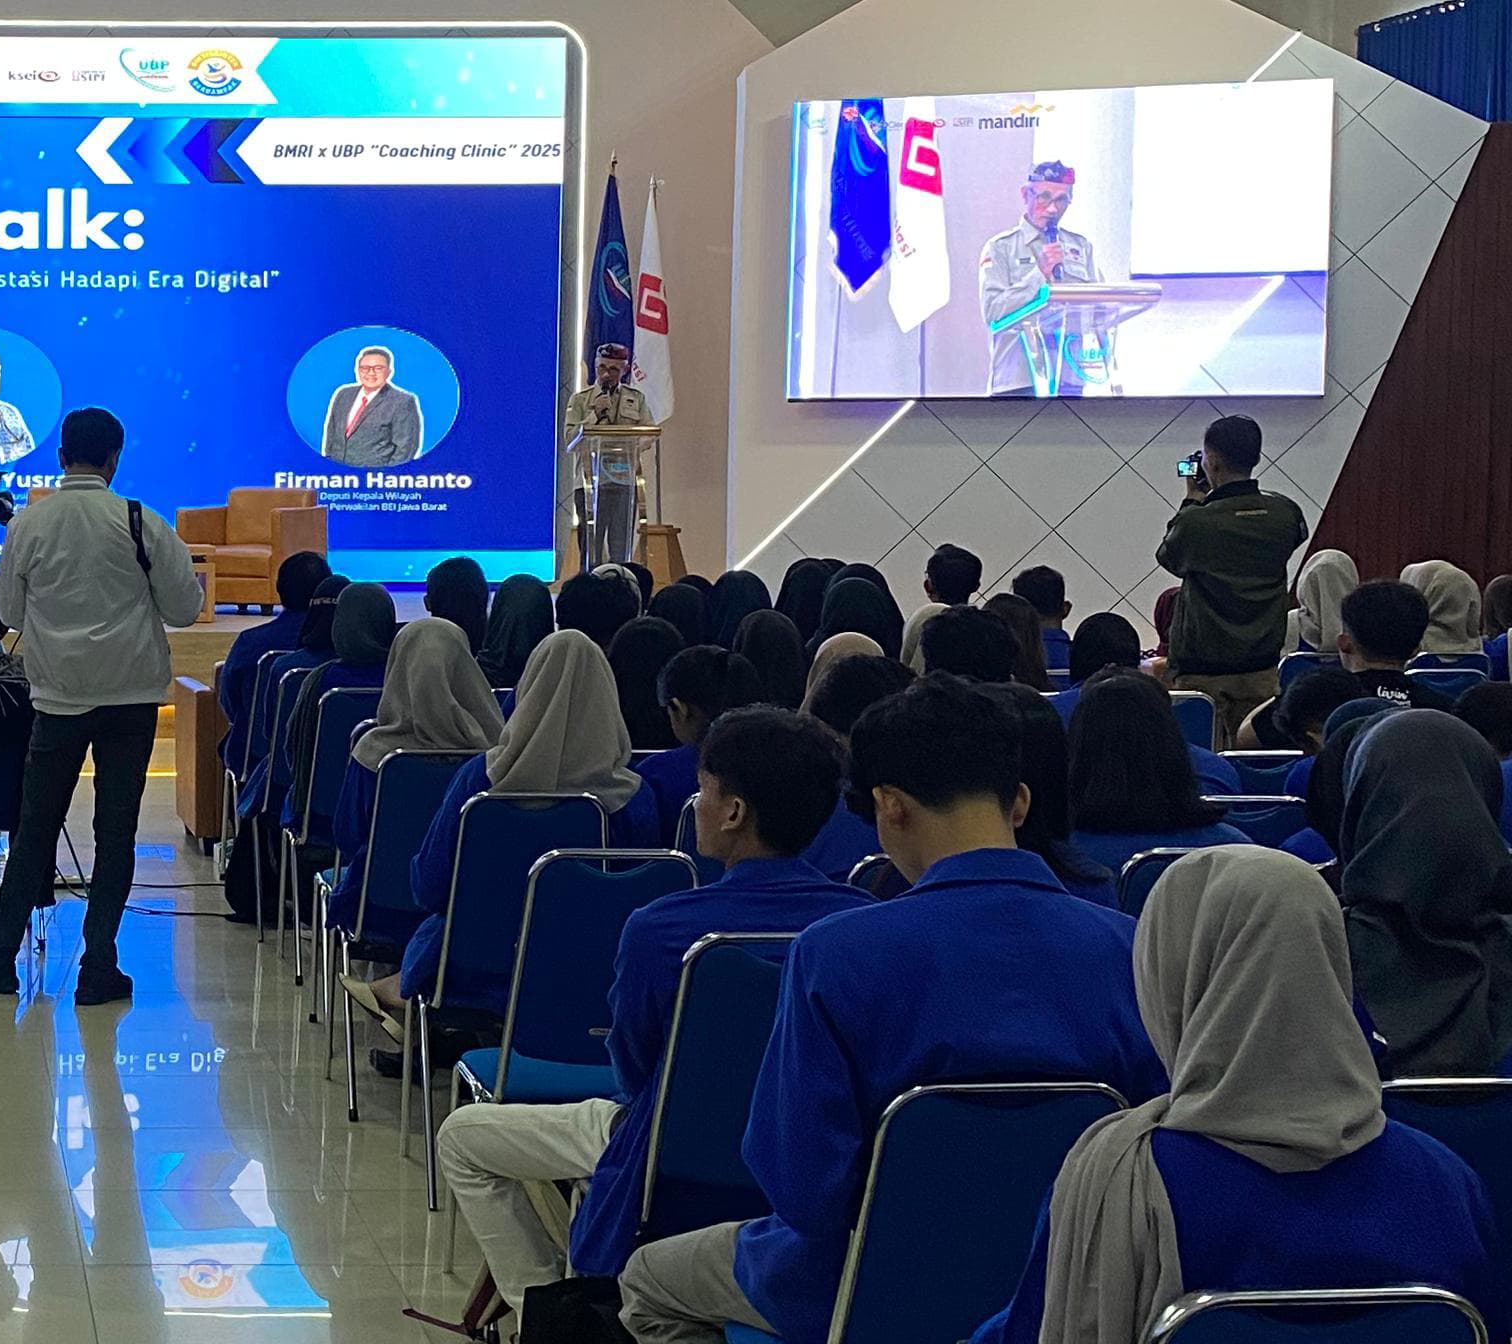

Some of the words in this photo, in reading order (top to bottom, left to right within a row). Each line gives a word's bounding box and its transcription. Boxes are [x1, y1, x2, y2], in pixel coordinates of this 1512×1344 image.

[139, 60, 169, 71] UBP
[273, 144, 313, 158] BMRI
[318, 147, 327, 158] x
[332, 144, 365, 158] UBP
[521, 143, 561, 157] 2025
[61, 269, 137, 291] Hadapi
[149, 269, 184, 288] Era
[274, 471, 359, 489] Firman
[366, 472, 472, 489] Hananto
[352, 492, 384, 501] Kepala
[385, 491, 422, 501] Wilayah
[397, 503, 420, 512] Jawa
[421, 503, 448, 511] Barat
